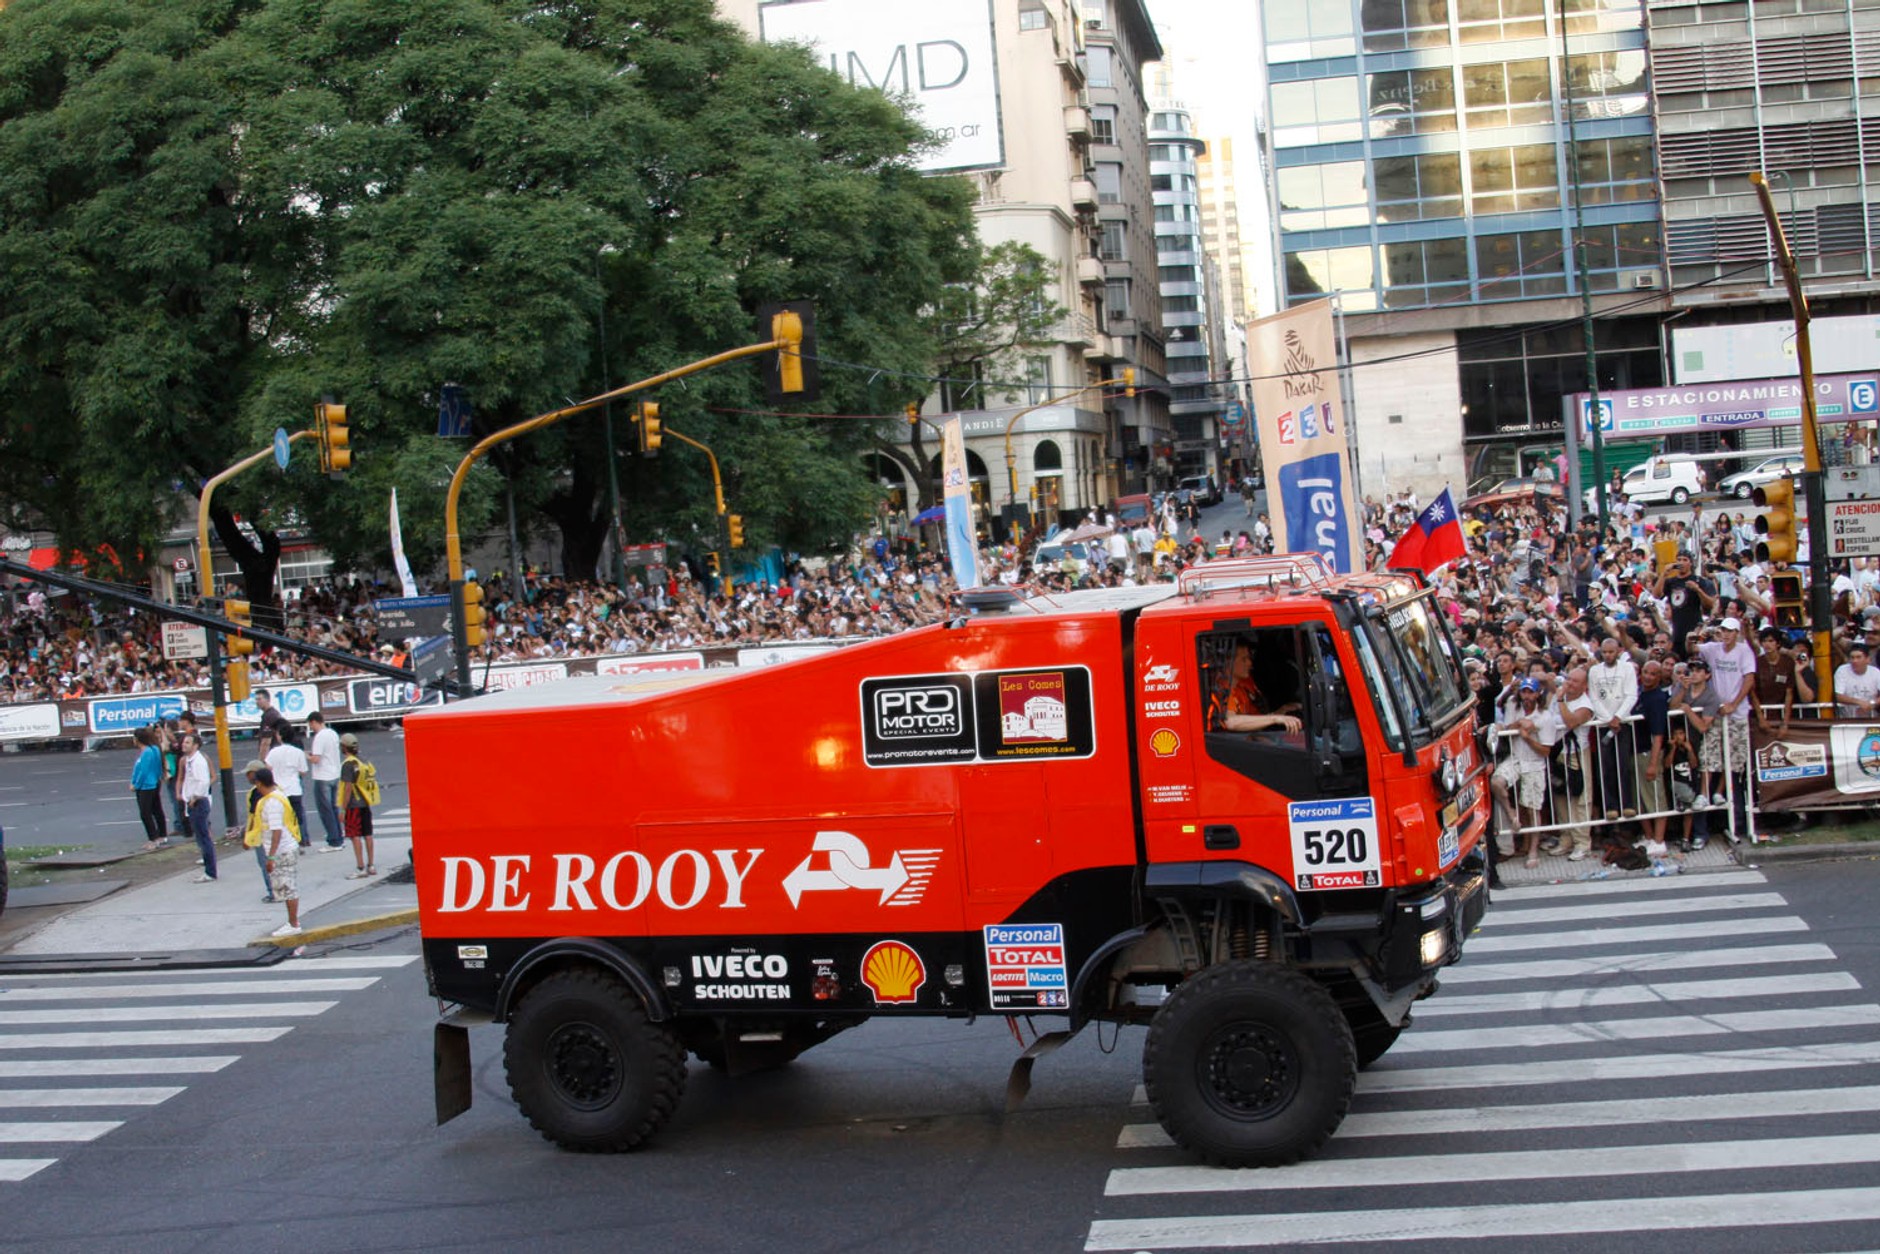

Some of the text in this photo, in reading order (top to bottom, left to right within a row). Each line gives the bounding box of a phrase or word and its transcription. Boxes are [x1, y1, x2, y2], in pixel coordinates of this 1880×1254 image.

[1284, 377, 1324, 400] DAKAR
[1627, 382, 1832, 409] ESTACIONAMIENO
[1859, 388, 1869, 404] E
[1706, 412, 1760, 422] ENTRADA
[927, 417, 1004, 435] NOANDIE
[1282, 424, 1294, 441] 2
[1002, 679, 1062, 692] Les Comes
[369, 683, 404, 705] elf
[881, 690, 952, 714] PRO
[1144, 700, 1180, 711] IVECO
[98, 708, 156, 724] Personal
[883, 714, 956, 730] MOTOR
[1292, 805, 1342, 818] Personal
[1303, 828, 1367, 866] 520
[437, 848, 764, 912] DE ROOY
[1313, 875, 1363, 885] TOTAL
[989, 926, 1057, 942] Personal
[990, 948, 1061, 963] TOTAL
[691, 954, 789, 978] IVECO
[992, 973, 1025, 982] LOCTITE
[1029, 972, 1063, 982] Macro
[694, 984, 791, 999] SCHOUTEN
